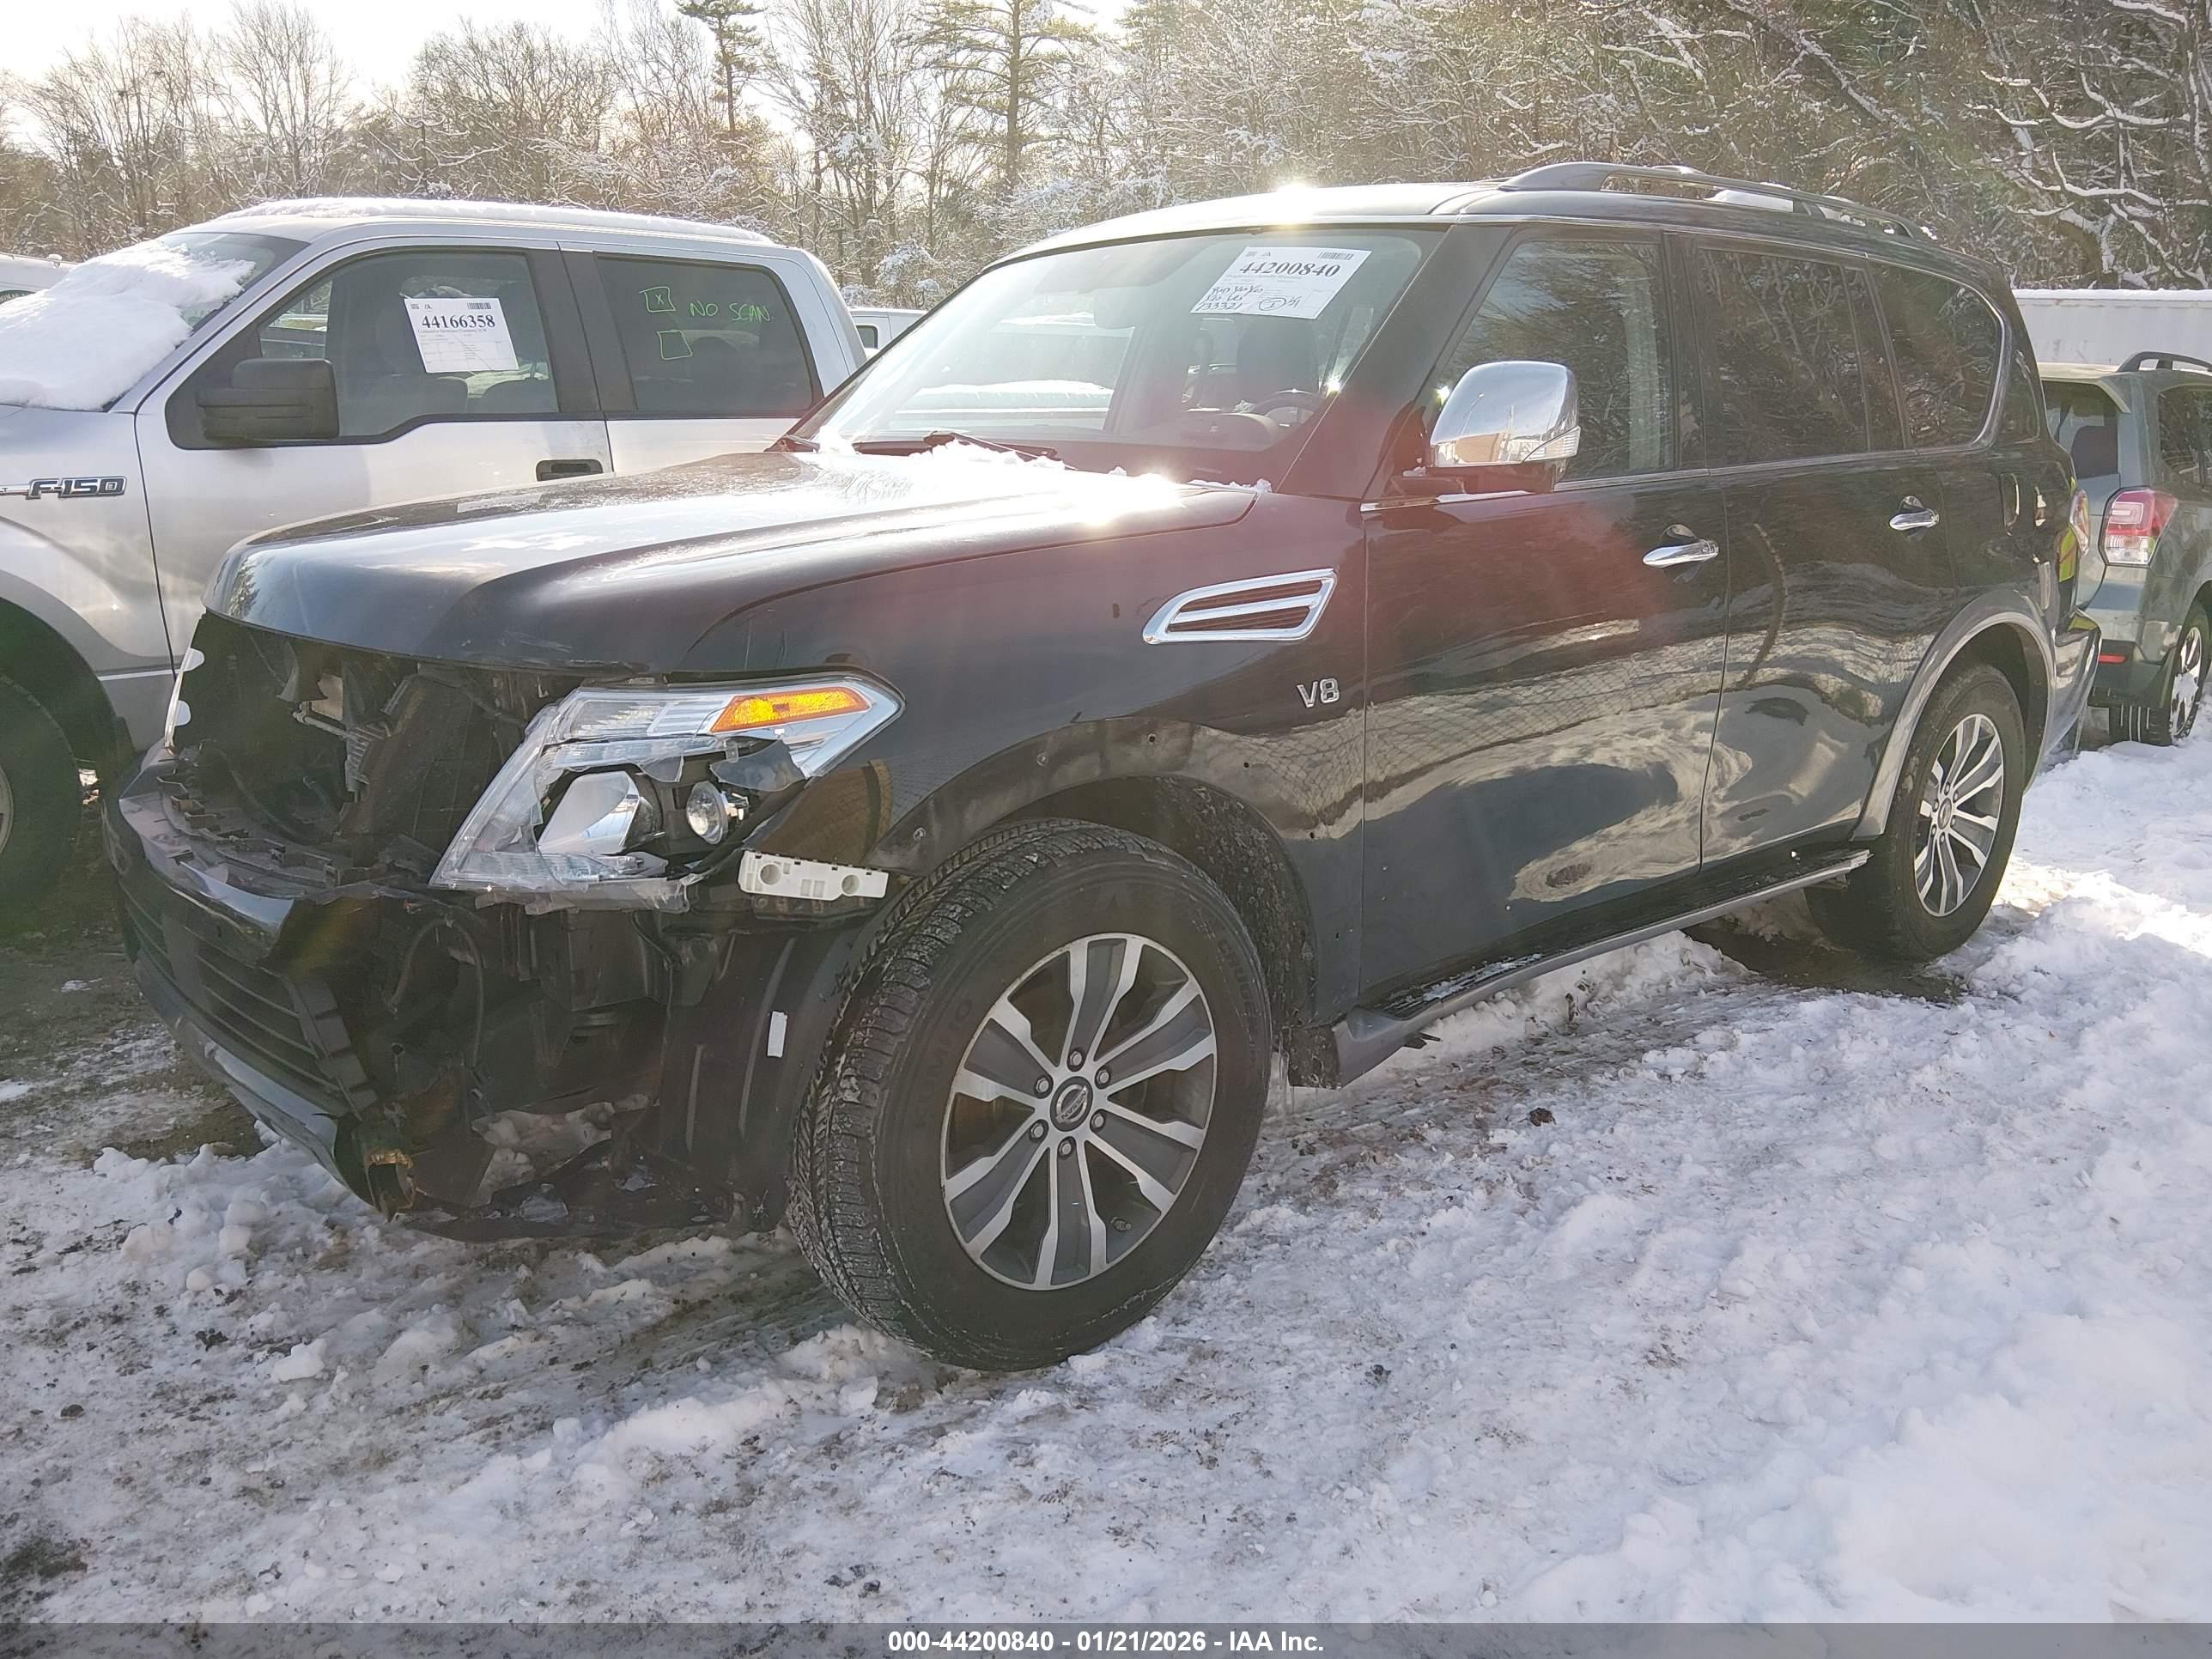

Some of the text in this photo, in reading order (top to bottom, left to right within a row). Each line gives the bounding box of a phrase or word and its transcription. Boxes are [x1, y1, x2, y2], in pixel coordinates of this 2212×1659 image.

[1239, 260, 1341, 277] 44200840
[422, 314, 495, 329] 44166358
[689, 301, 771, 324] NO SCAN
[27, 476, 127, 500] F-150
[1296, 678, 1340, 708] V8
